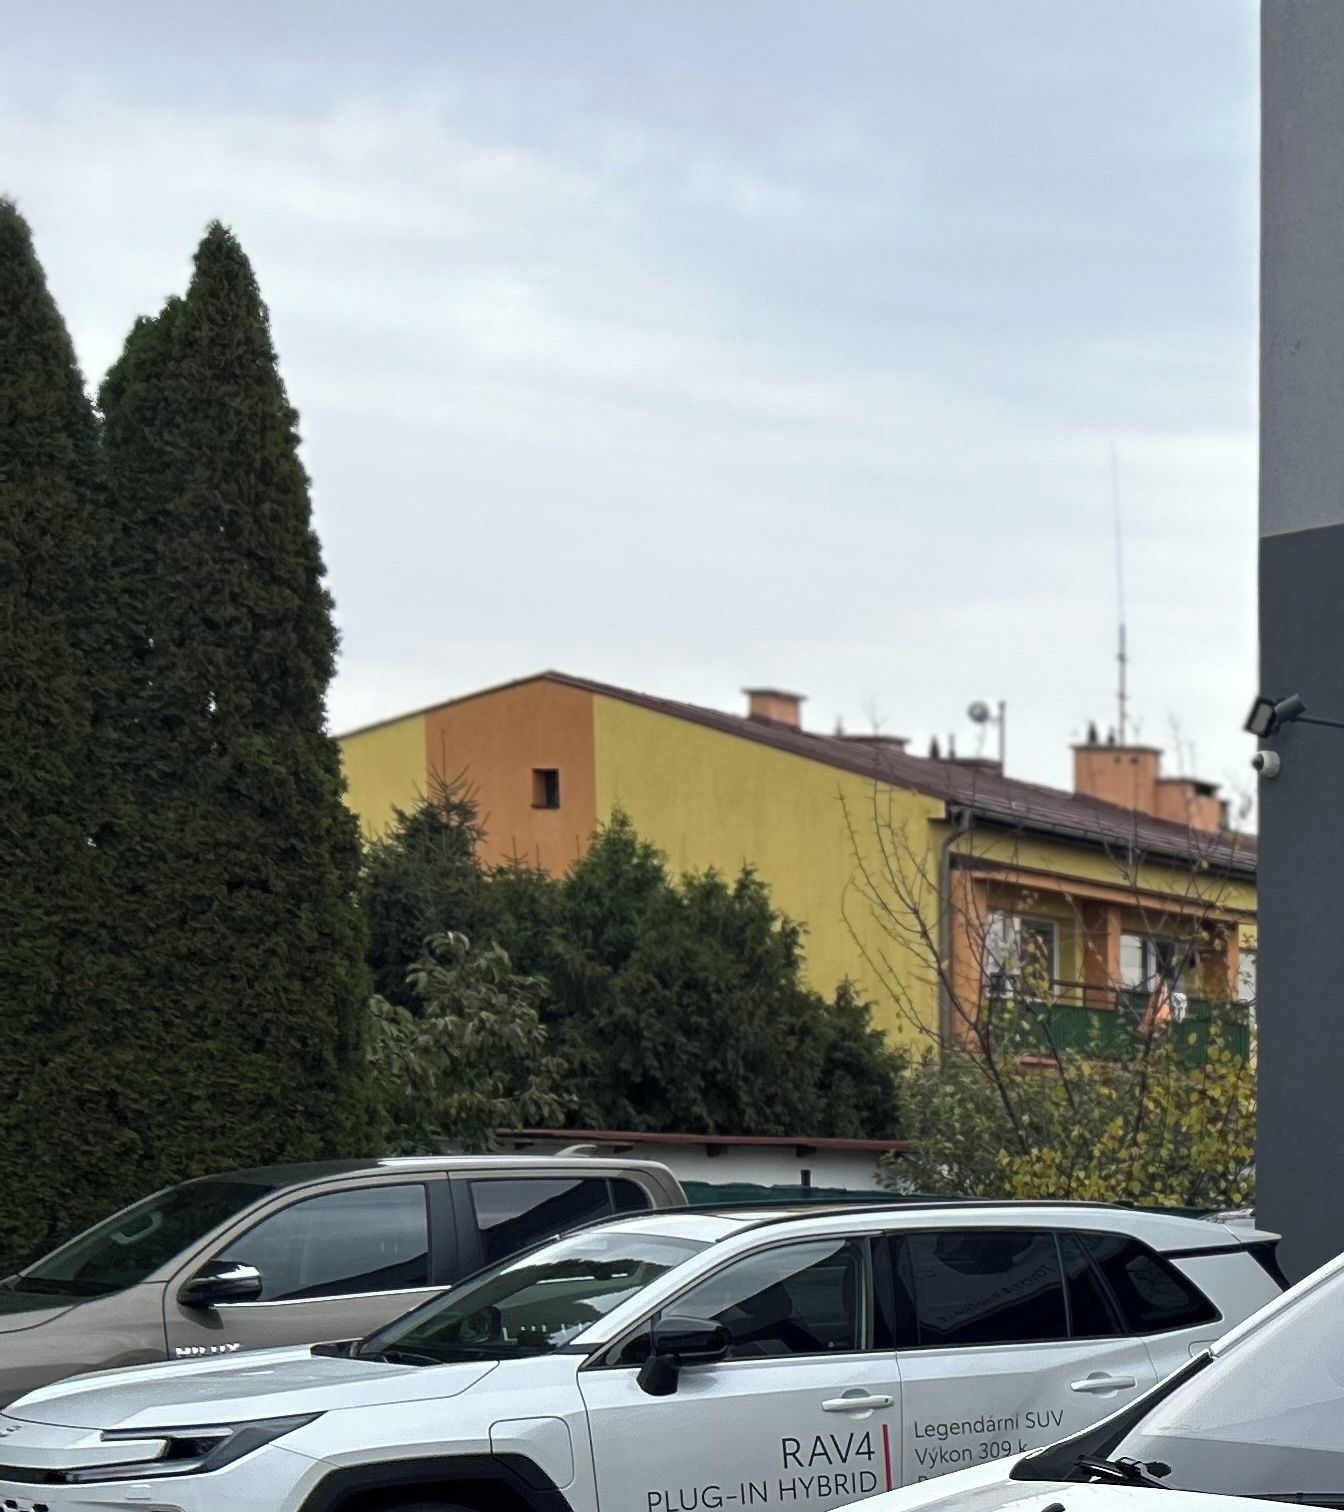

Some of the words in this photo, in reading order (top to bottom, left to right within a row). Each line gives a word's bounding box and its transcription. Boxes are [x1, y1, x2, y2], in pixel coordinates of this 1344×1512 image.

[914, 1412, 1020, 1441] Legendární
[1025, 1409, 1064, 1429] SUV
[781, 1431, 876, 1469] RAV4
[914, 1445, 973, 1469] Výkon
[979, 1440, 1013, 1460] 309
[779, 1470, 879, 1501] HYBRID
